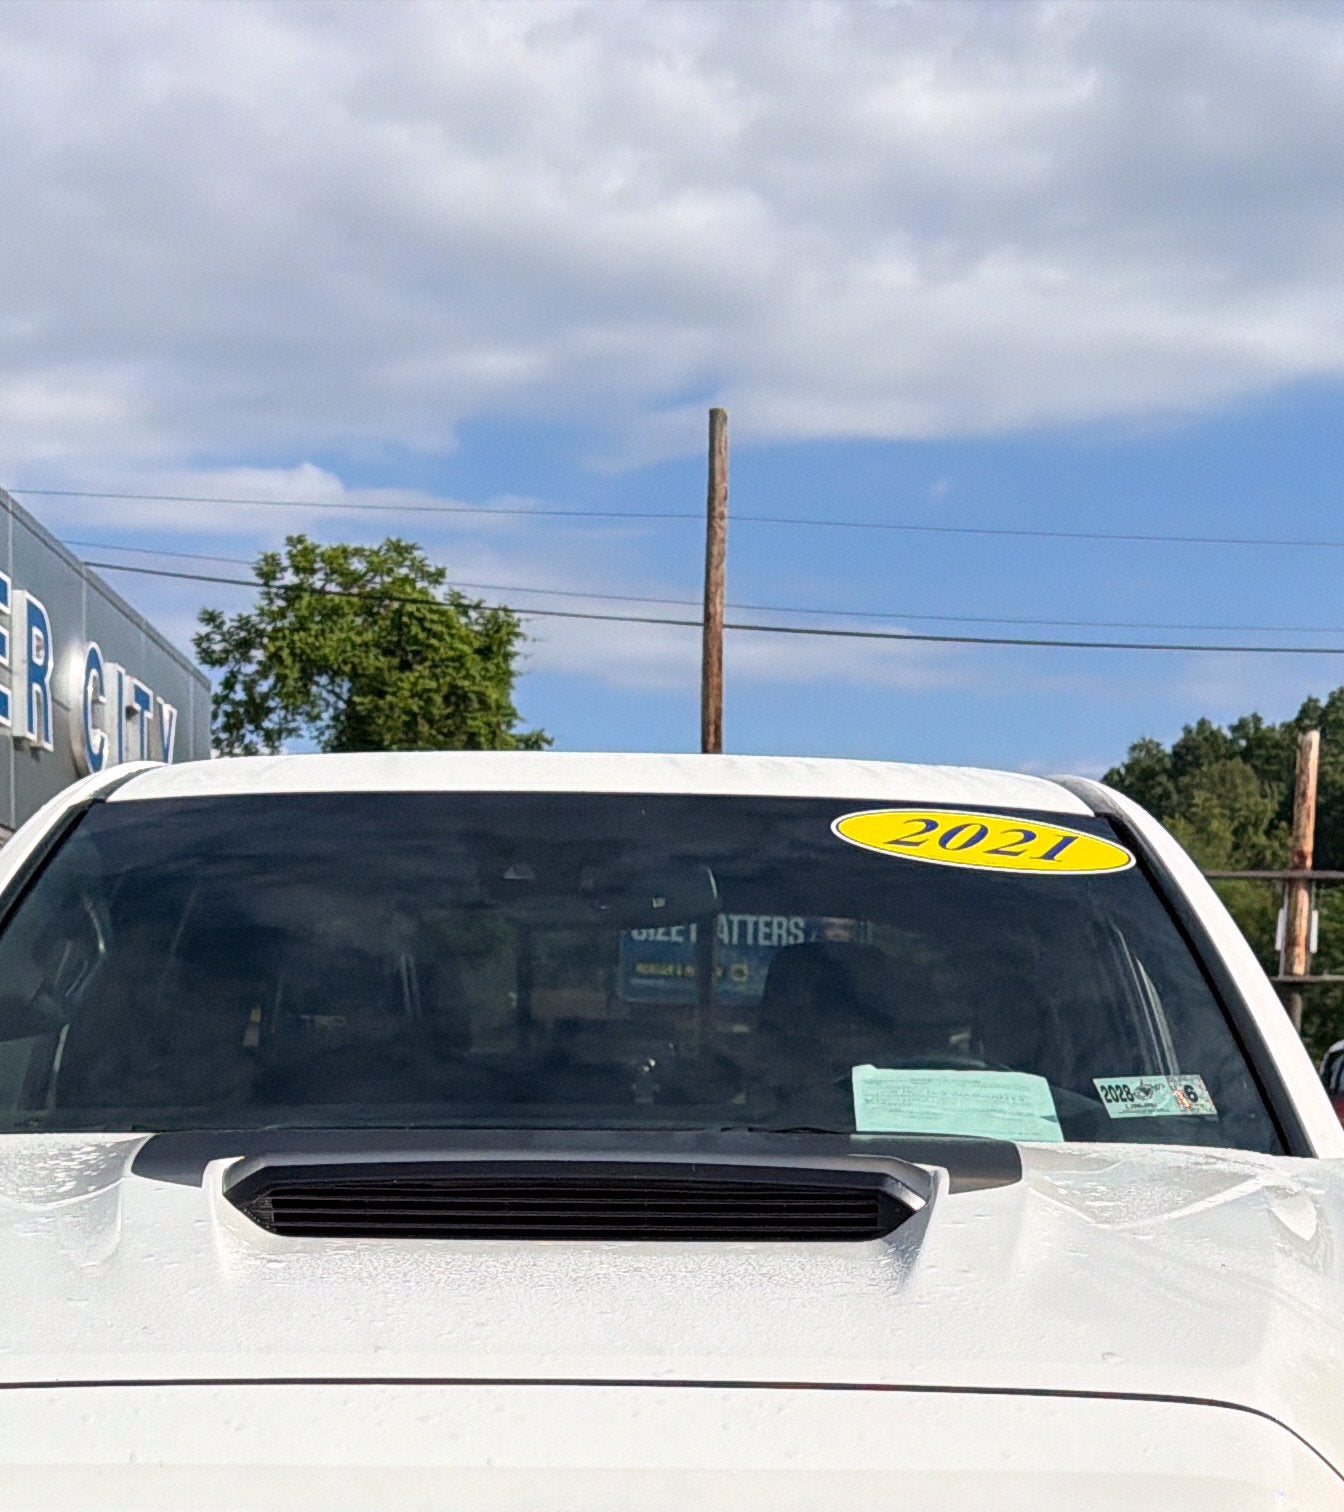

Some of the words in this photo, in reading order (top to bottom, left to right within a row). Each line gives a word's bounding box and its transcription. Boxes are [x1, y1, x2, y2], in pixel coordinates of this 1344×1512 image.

[70, 640, 178, 774] CITY
[883, 818, 1079, 862] 2021
[689, 913, 806, 946] ATTERS
